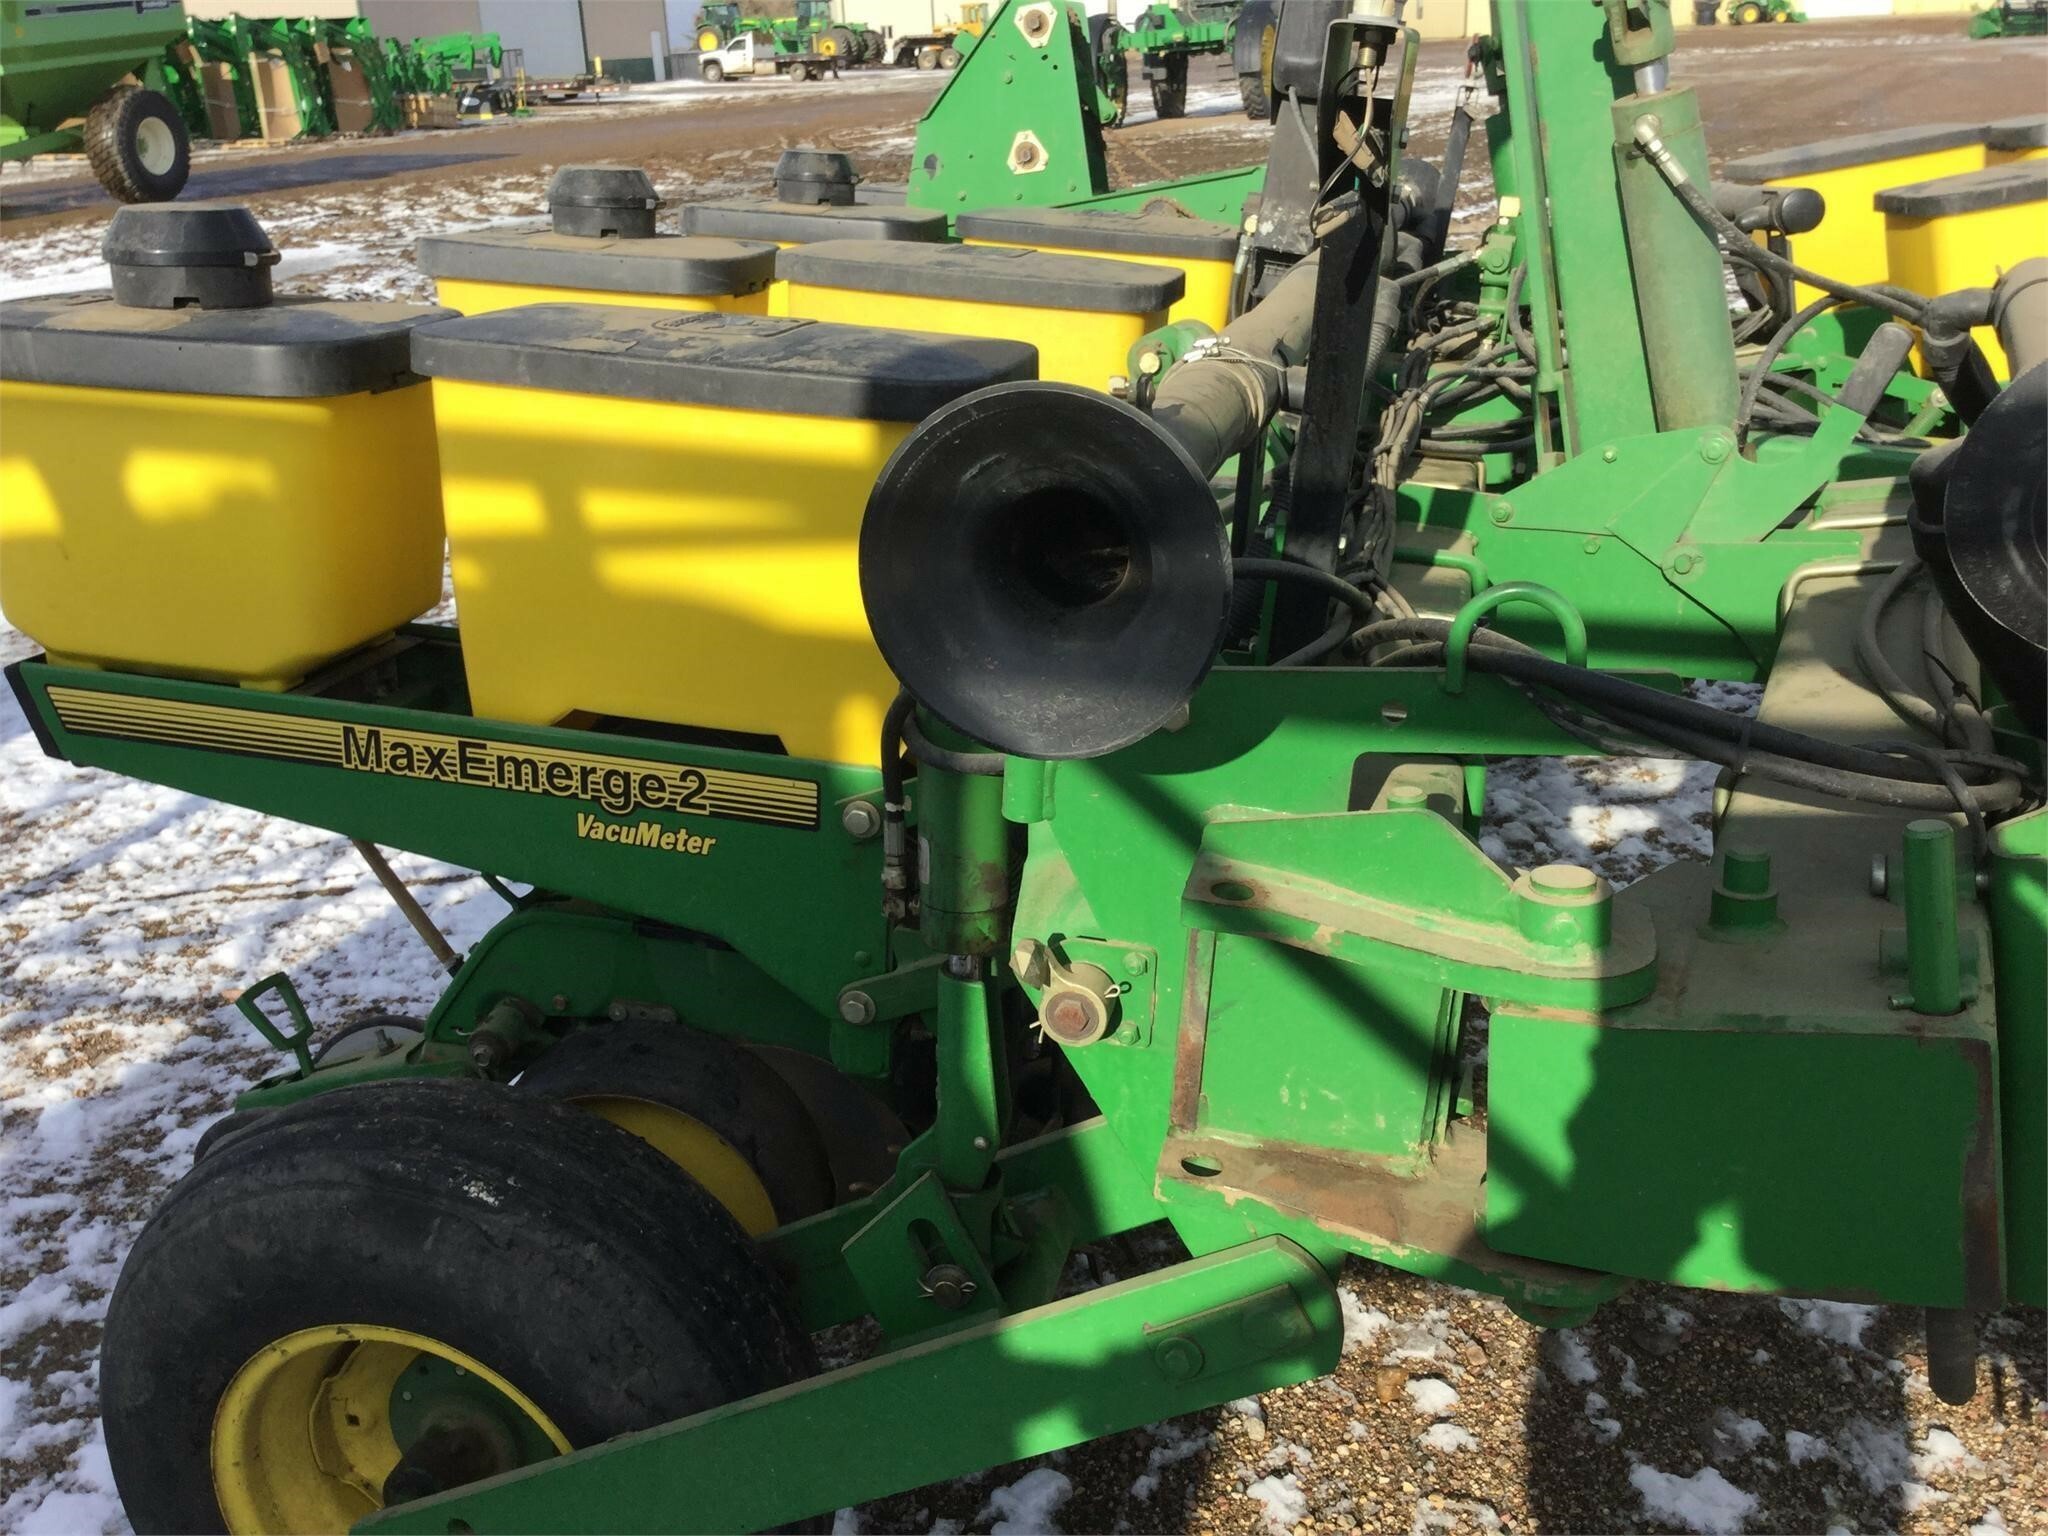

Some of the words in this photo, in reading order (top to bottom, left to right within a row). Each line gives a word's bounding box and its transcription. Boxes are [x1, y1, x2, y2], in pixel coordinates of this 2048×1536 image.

[341, 726, 668, 815] MaxEmerge
[675, 769, 711, 816] 2
[576, 812, 717, 856] VacuMeter
